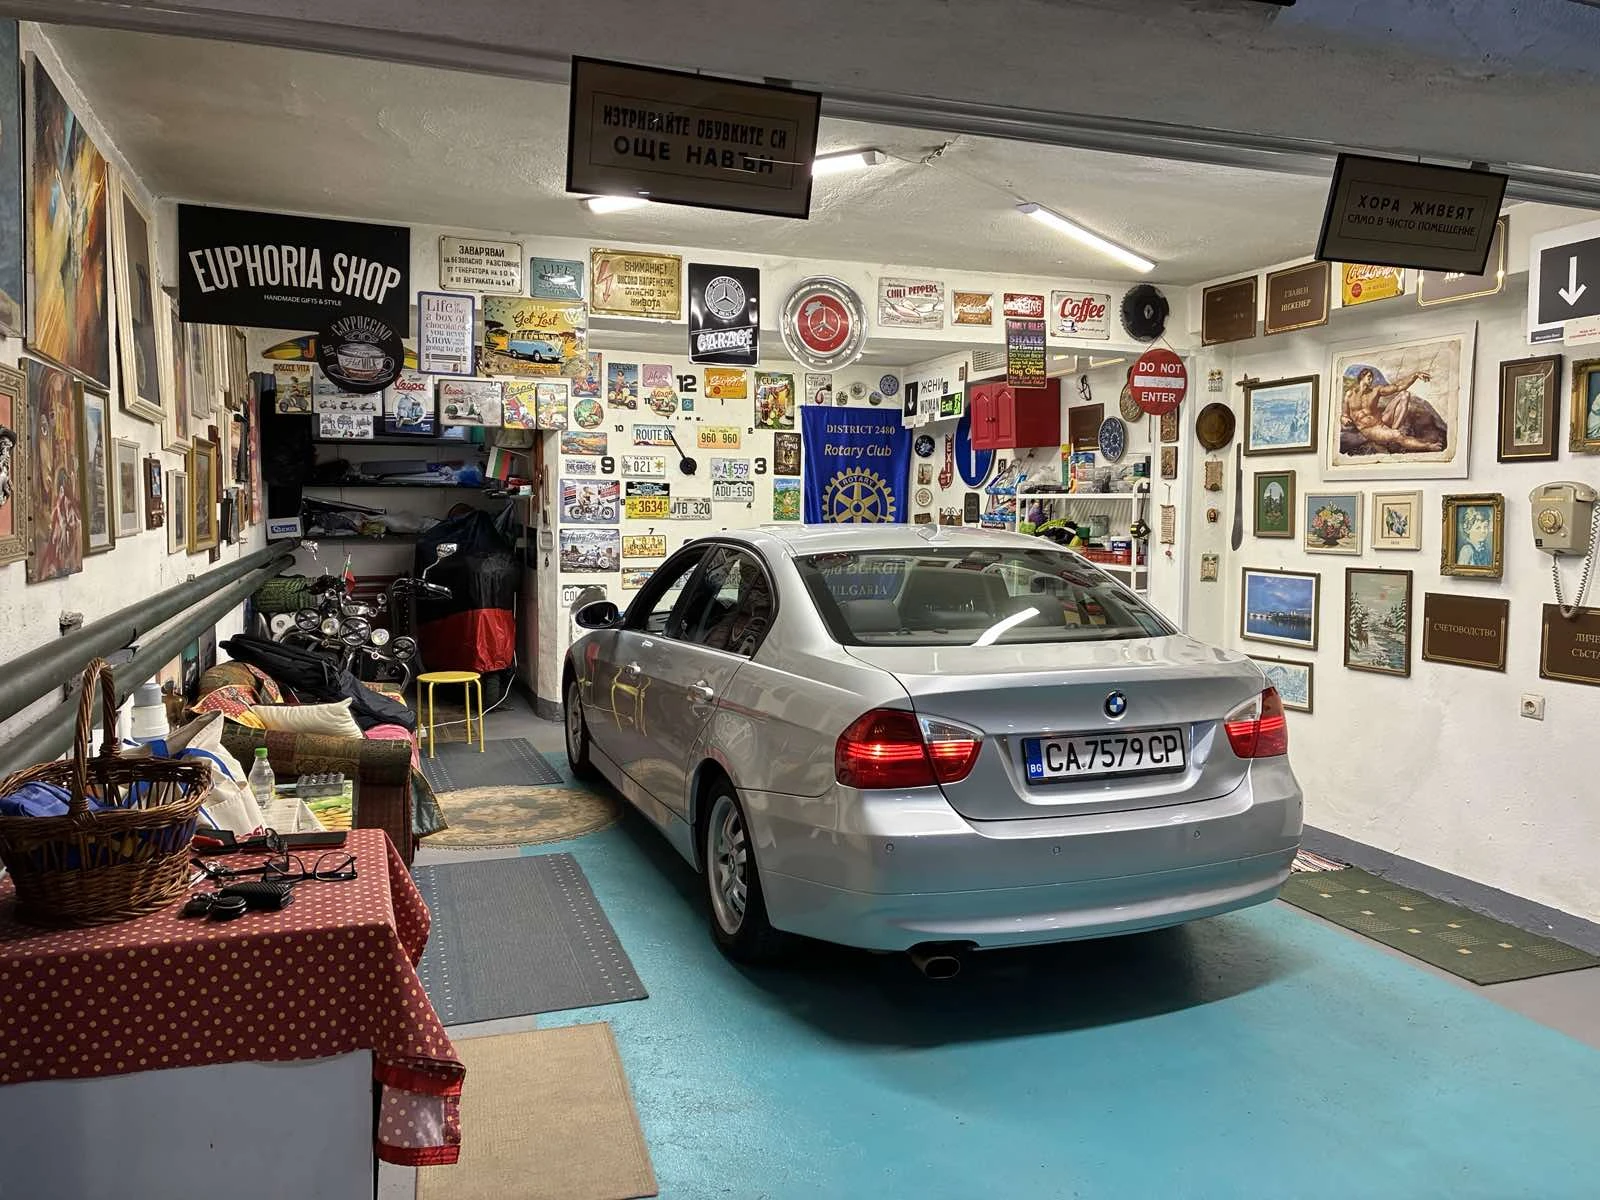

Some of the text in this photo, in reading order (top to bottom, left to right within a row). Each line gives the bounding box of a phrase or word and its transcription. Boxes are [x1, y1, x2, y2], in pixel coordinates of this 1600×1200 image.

[697, 118, 764, 146] ОБУВКИТЕ
[770, 128, 787, 150] СИ
[613, 135, 774, 175] ОЩЕ НАВЪН
[1357, 195, 1475, 221] ХОРА ЖИВЕЯТ
[1347, 214, 1375, 225] САМО
[1377, 216, 1384, 226] В
[1386, 217, 1416, 230] ЧИСТО
[624, 261, 667, 274] ВНИМАНИЕ!
[188, 244, 401, 305] EUPHORIA SHOP
[886, 285, 938, 298] CHILI PEPPERS
[263, 294, 300, 303] HANDMADE
[300, 296, 318, 305] GIFTS
[324, 298, 342, 307] STYLE
[427, 299, 453, 313] Life
[1060, 297, 1105, 323] Coffee
[435, 313, 452, 322] box
[512, 311, 560, 327] Get Lost
[331, 315, 393, 341] CAPPUCCINO
[426, 334, 452, 344] know
[697, 328, 754, 352] GARAGE
[1009, 335, 1044, 344] SHARE
[1009, 368, 1023, 376] Hug
[1139, 362, 1182, 373] DO NOT
[393, 377, 427, 391] Vespa
[676, 375, 697, 392] 12
[1141, 392, 1176, 402] ENTER
[614, 424, 624, 432] 10
[636, 428, 662, 440] ROUTE
[747, 427, 754, 435] 2
[826, 425, 896, 435] DISTRICT 2480
[701, 433, 737, 443] 960 960
[824, 443, 892, 459] Rotary Club
[601, 456, 615, 474] 9
[633, 461, 651, 472] 021
[733, 464, 749, 475] 559
[754, 457, 767, 475] 3
[842, 475, 875, 486] ROTARY
[715, 487, 753, 497] ADU-156
[639, 500, 663, 513] 3634
[670, 502, 711, 515] JTB 320
[1433, 622, 1497, 638] СЧЕТОВОДСТВО
[1085, 738, 1144, 769] 7579
[1149, 735, 1178, 763] CP
[1030, 765, 1042, 773] BG
